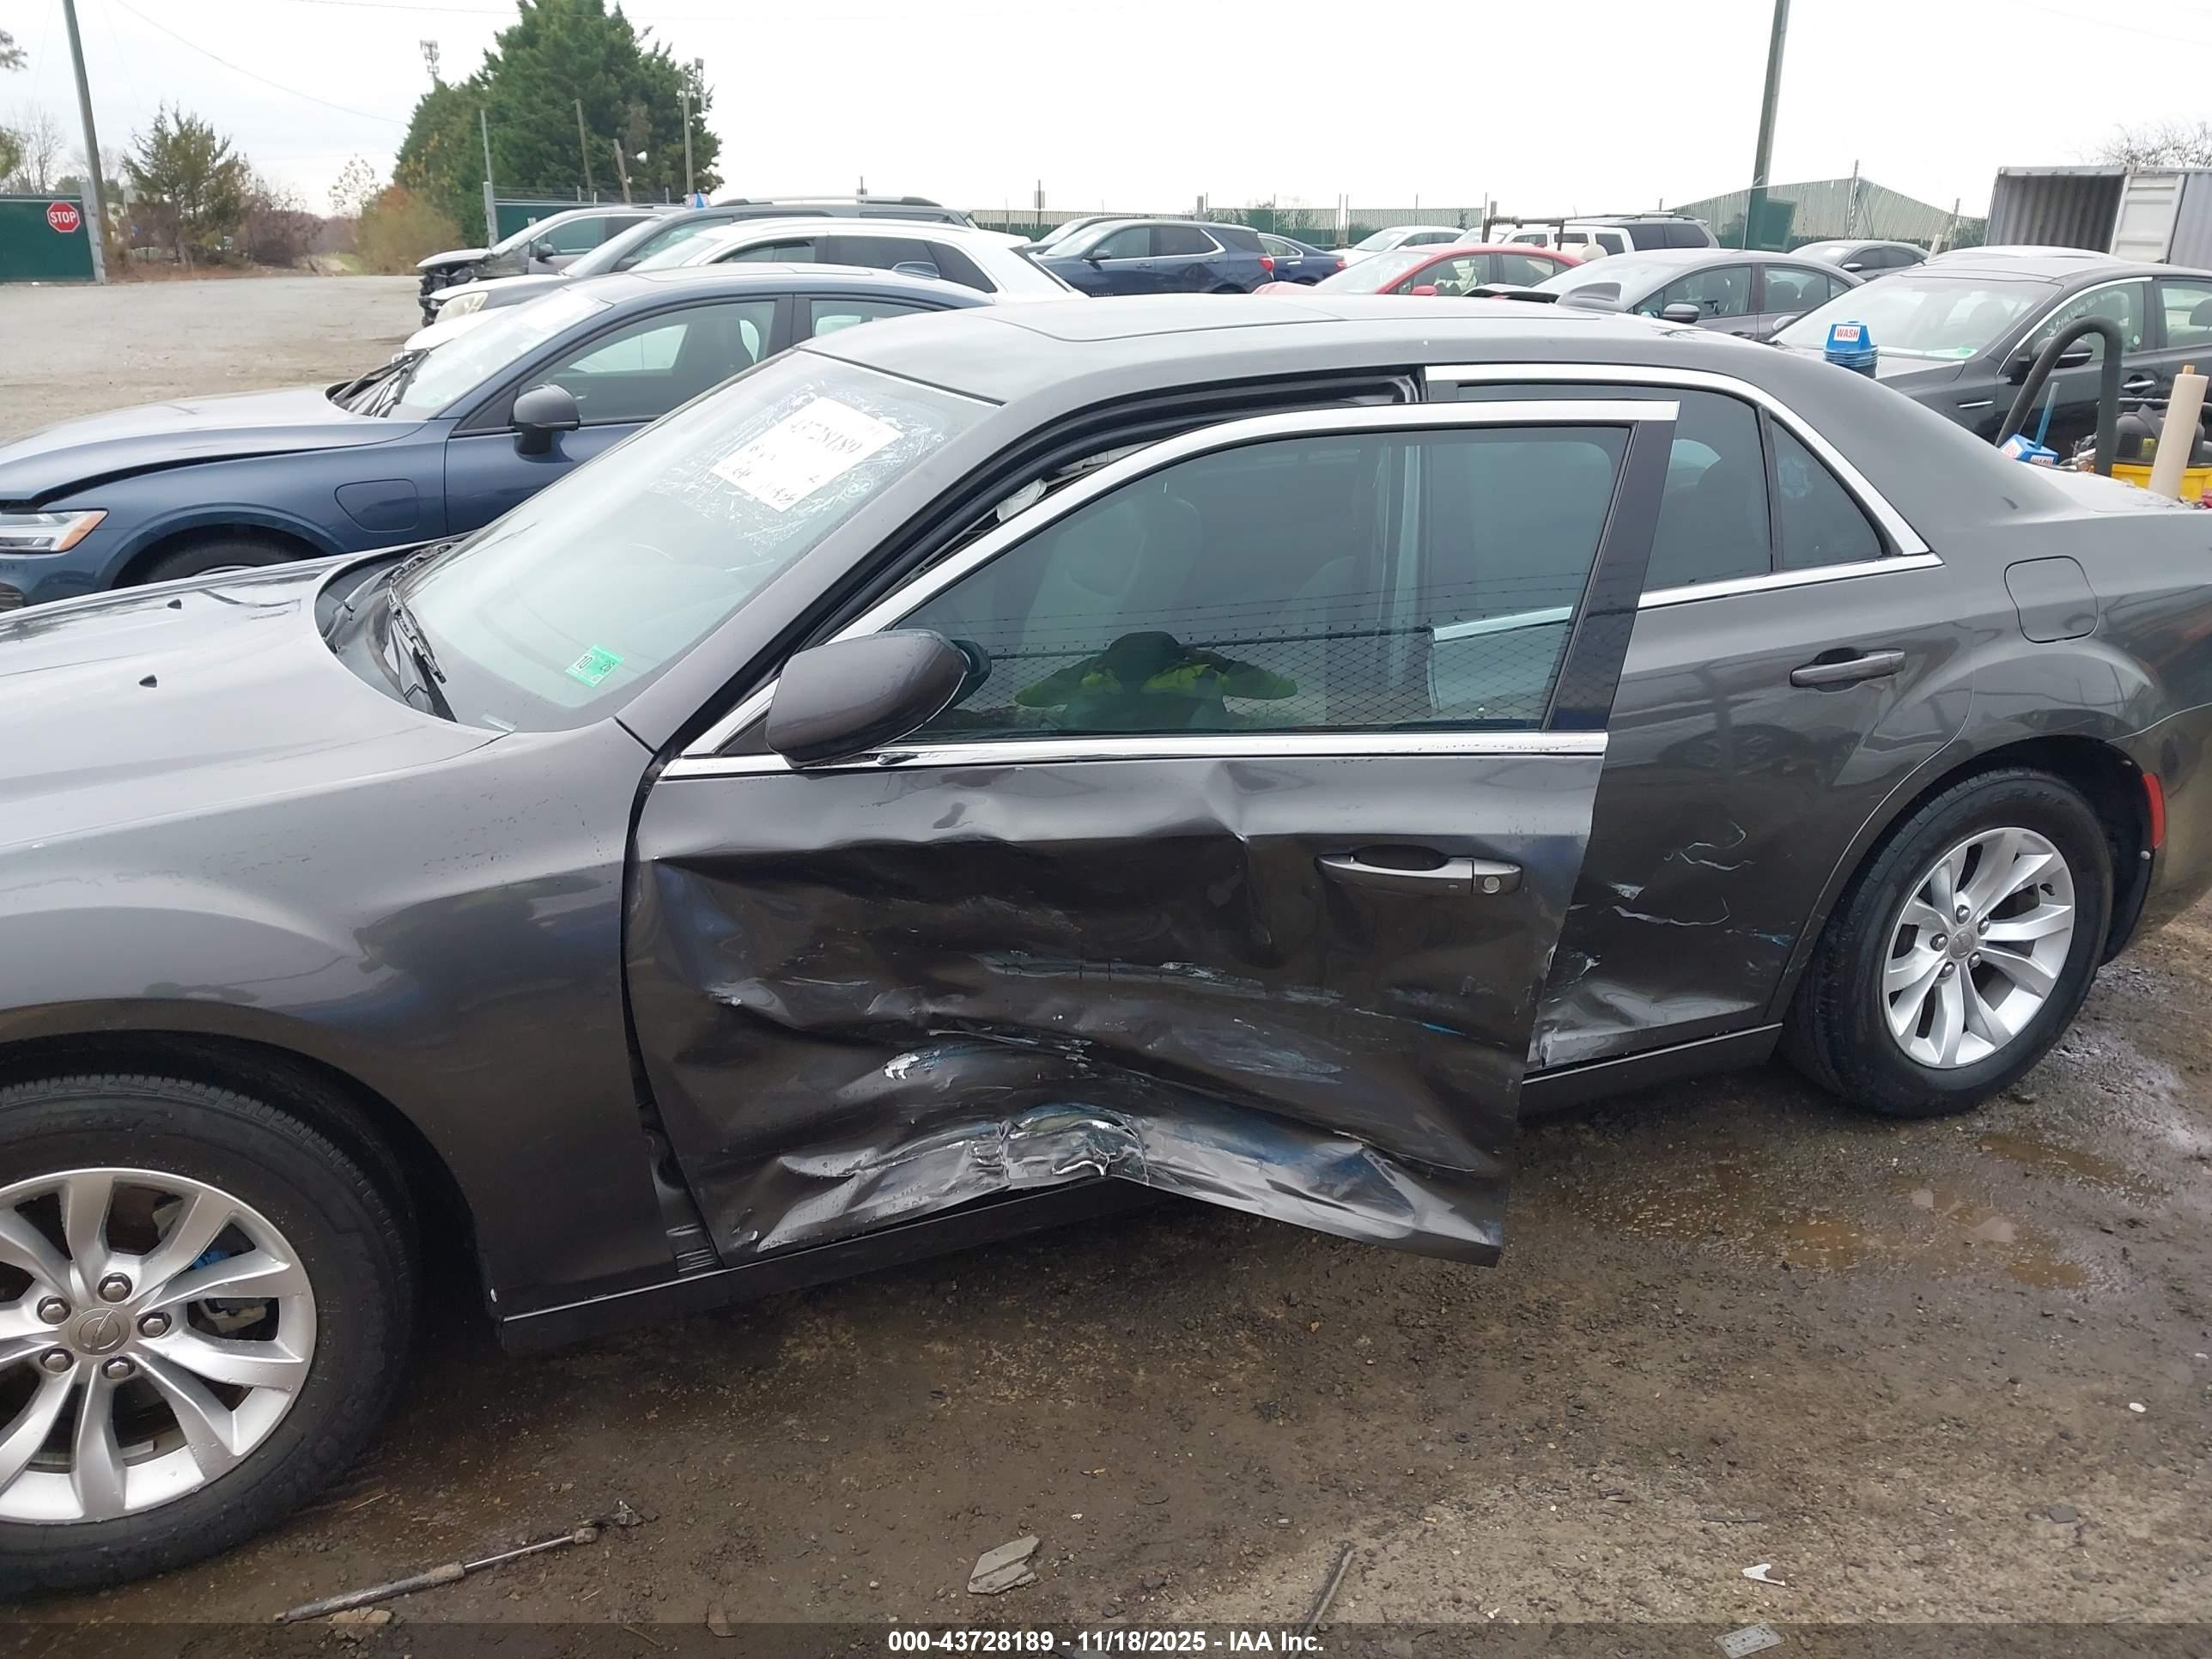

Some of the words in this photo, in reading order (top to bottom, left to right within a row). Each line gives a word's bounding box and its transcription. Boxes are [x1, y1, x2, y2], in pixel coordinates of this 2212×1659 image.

[49, 211, 76, 223] STOP
[1837, 328, 1859, 338] WASH
[576, 655, 593, 669] 10
